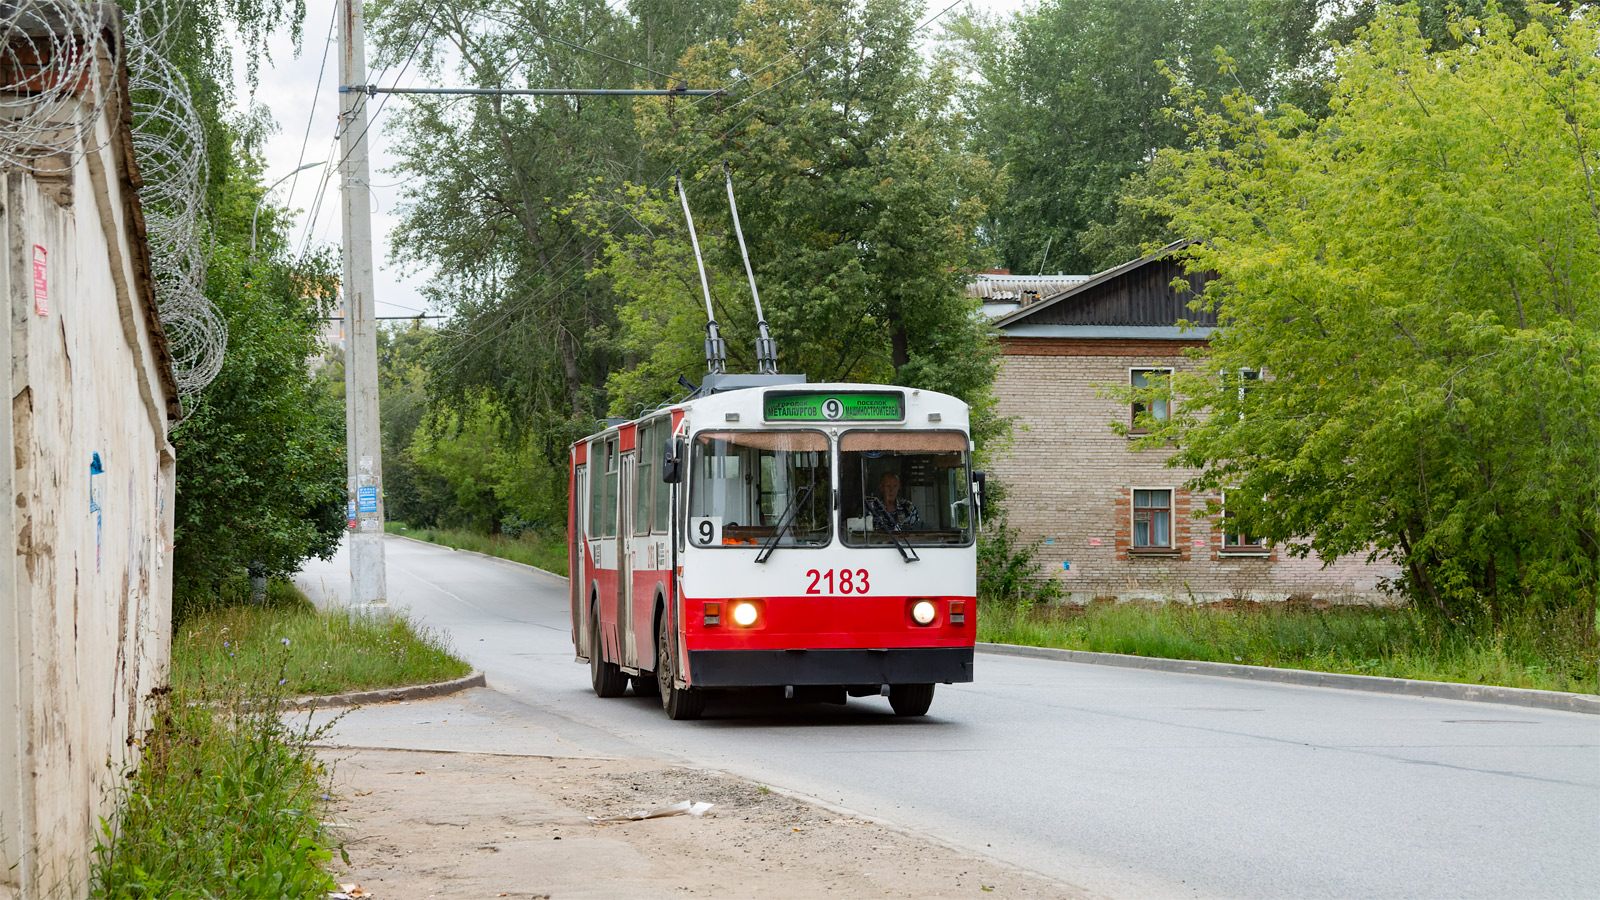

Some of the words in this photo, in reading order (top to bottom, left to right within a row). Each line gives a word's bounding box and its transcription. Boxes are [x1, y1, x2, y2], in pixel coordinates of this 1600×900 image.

[767, 406, 818, 417] МЕТАЛЛУРГОВ
[826, 400, 839, 418] 9
[698, 520, 715, 545] 9
[805, 568, 870, 595] 2183
